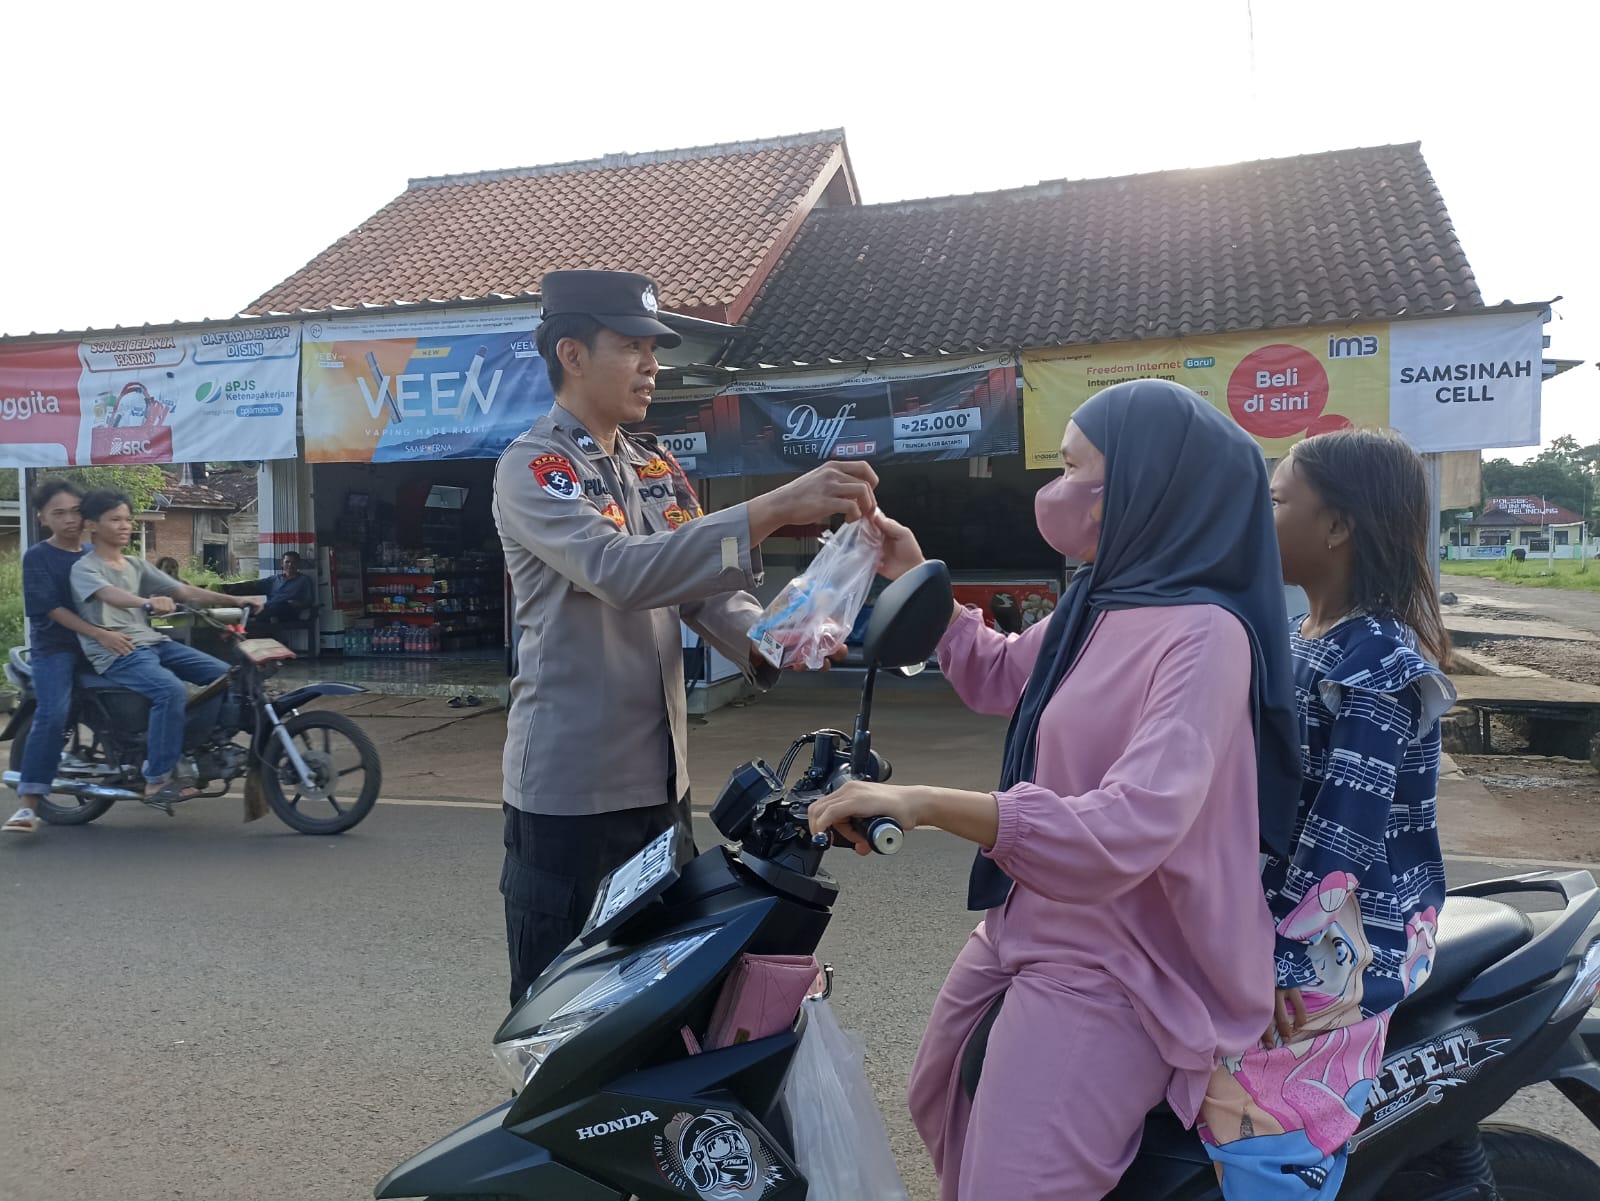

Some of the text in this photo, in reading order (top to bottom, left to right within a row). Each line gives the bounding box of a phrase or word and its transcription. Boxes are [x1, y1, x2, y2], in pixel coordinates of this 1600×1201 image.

[201, 331, 243, 345] DAFTAR
[253, 326, 290, 340] BAYAR
[90, 336, 176, 353] SOLUSI BELANJA
[227, 342, 264, 357] DI SINI
[114, 352, 156, 366] HARIAN
[1086, 365, 1135, 376] Freedom
[1136, 359, 1181, 373] Internet
[1255, 367, 1299, 389] Beli
[1399, 359, 1532, 384] SAMSINAH
[225, 380, 256, 392] BPJS
[1435, 385, 1495, 404] CELL
[225, 390, 295, 401] Ketenagakerjaan
[1243, 391, 1310, 413] di sini
[0, 390, 60, 421] ggita
[365, 428, 410, 437] VAPING
[782, 402, 857, 460] Duff
[122, 440, 152, 456] SRC
[783, 443, 818, 455] FILTER
[836, 443, 876, 456] BOLD
[575, 1110, 660, 1140] HONDA
